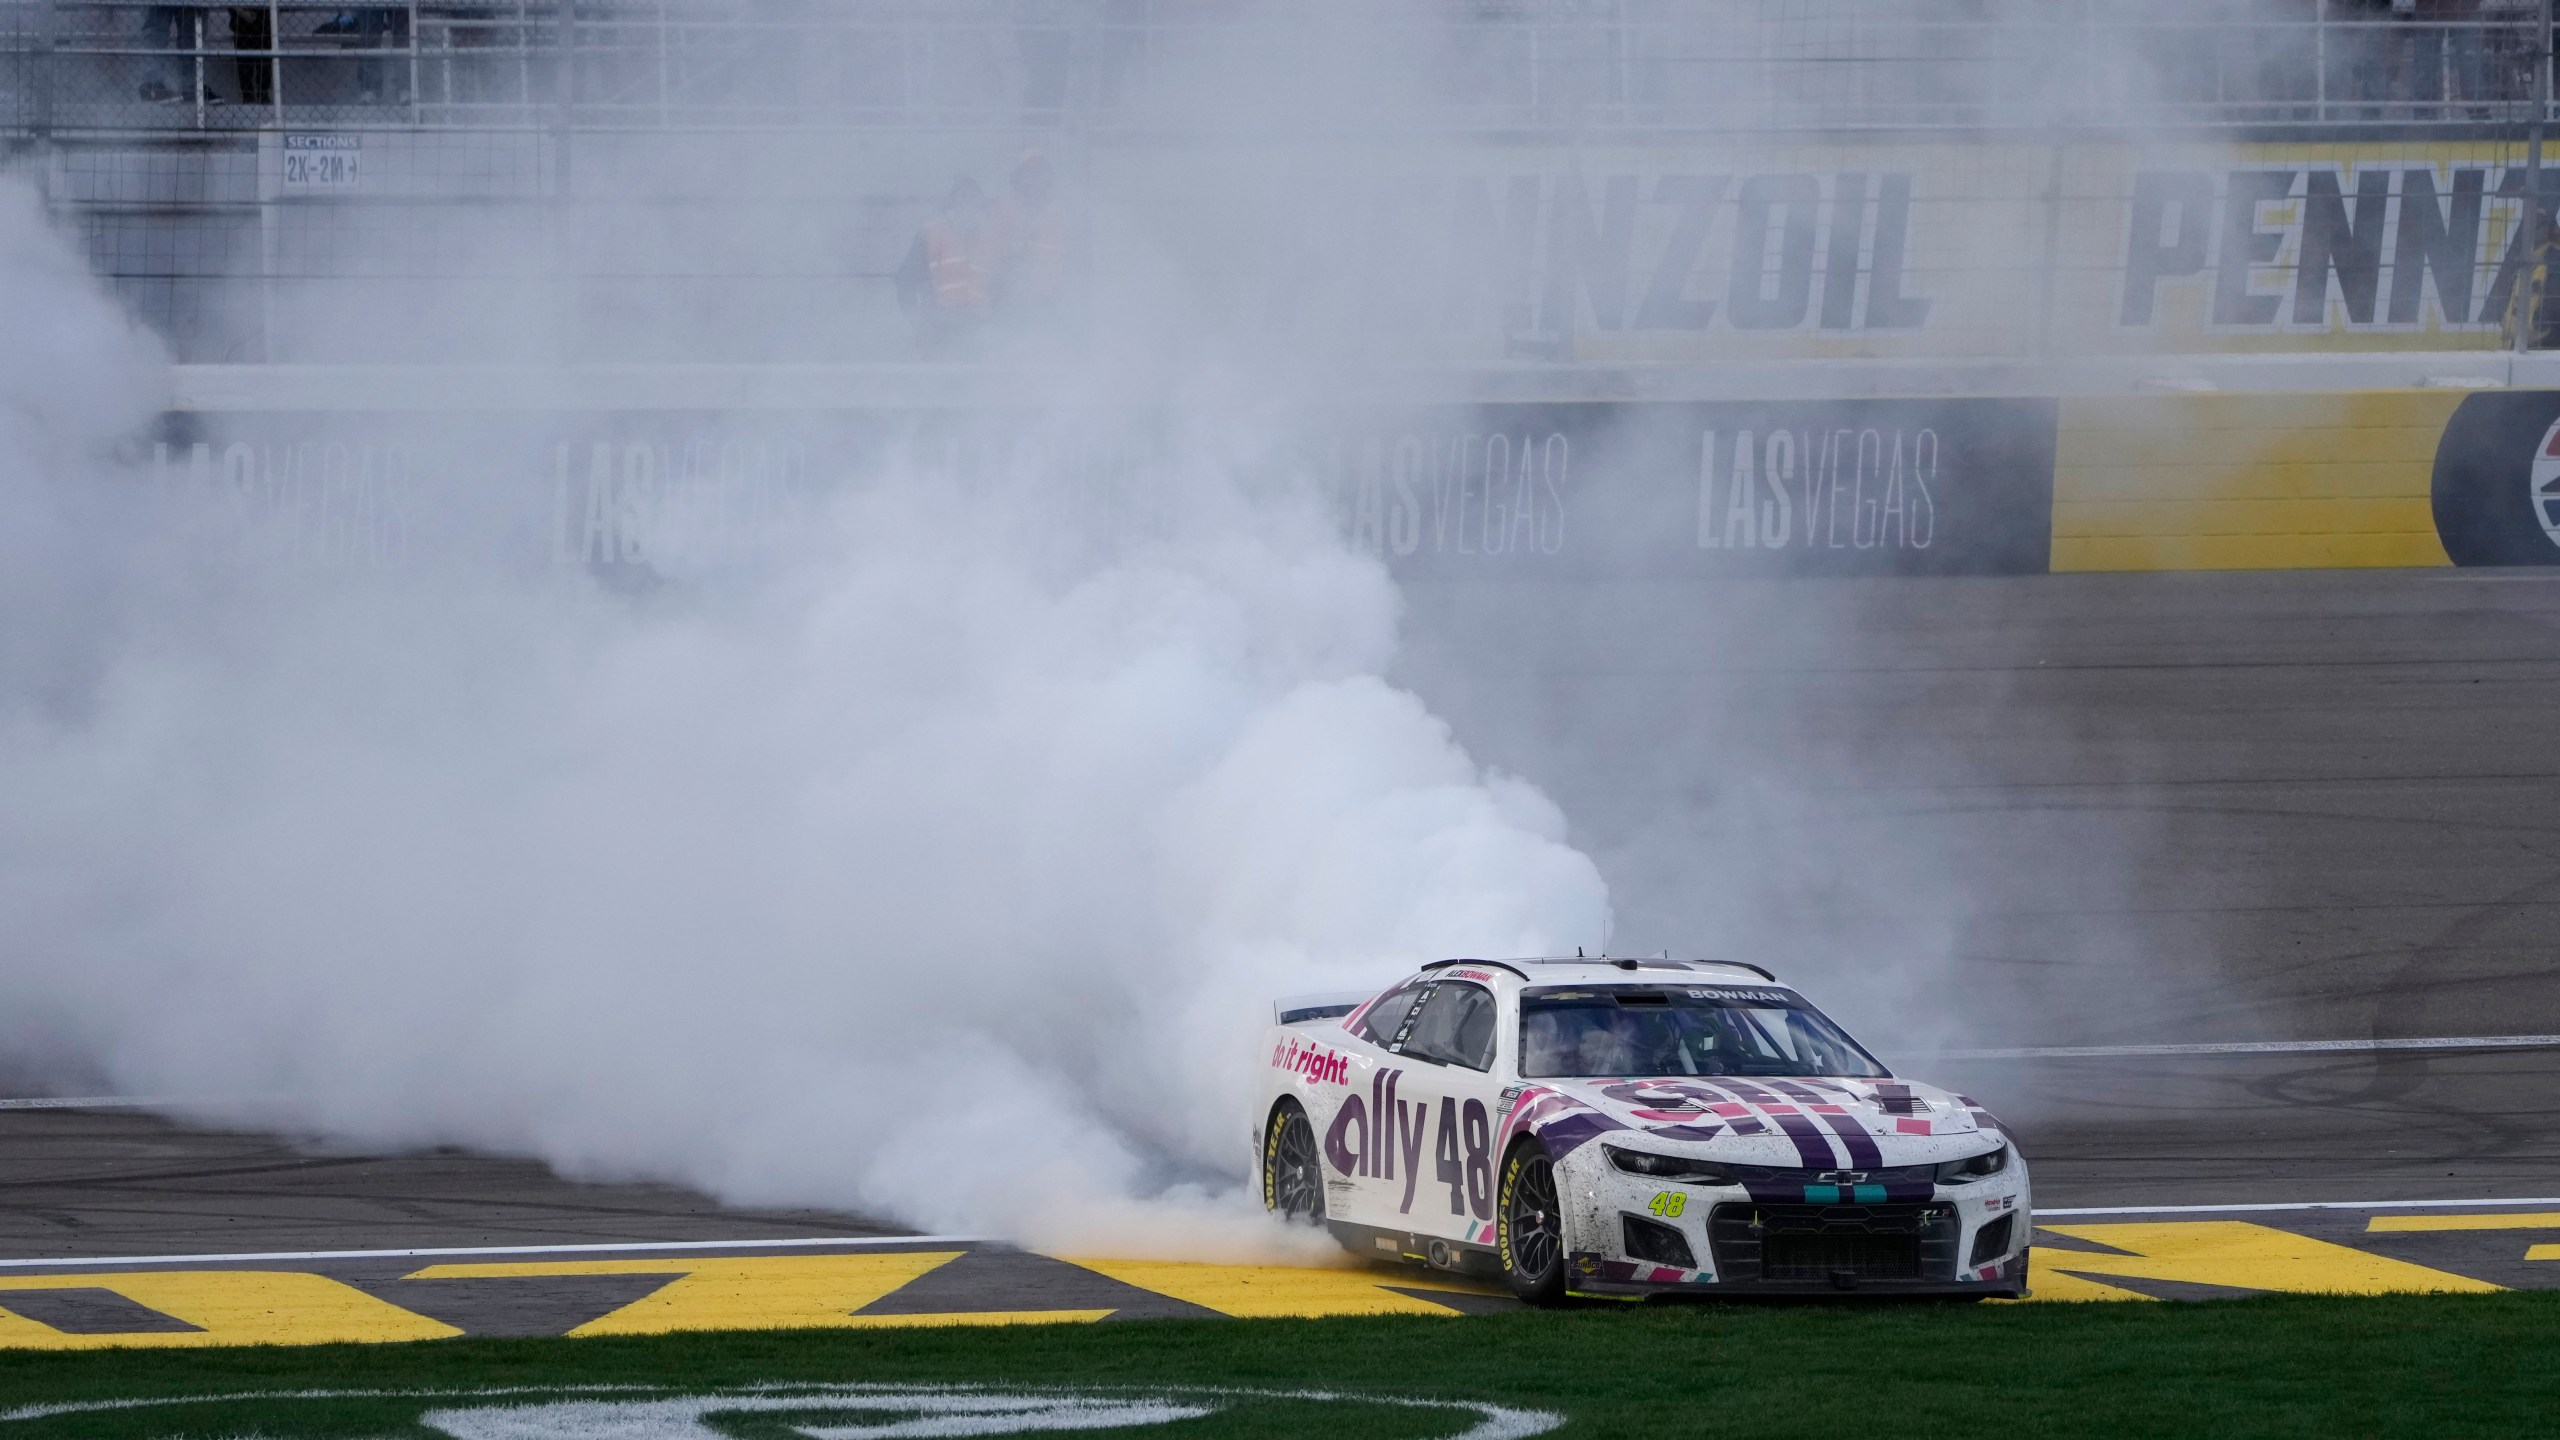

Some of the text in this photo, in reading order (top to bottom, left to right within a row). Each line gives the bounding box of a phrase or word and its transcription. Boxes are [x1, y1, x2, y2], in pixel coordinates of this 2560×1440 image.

[287, 135, 358, 149] SECTIONS
[1686, 989, 1790, 1002] BOWMAN
[1294, 1042, 1349, 1086] right.
[1324, 1067, 1428, 1215] ally
[1435, 1095, 1494, 1222] 48
[1647, 1190, 1688, 1218] 48
